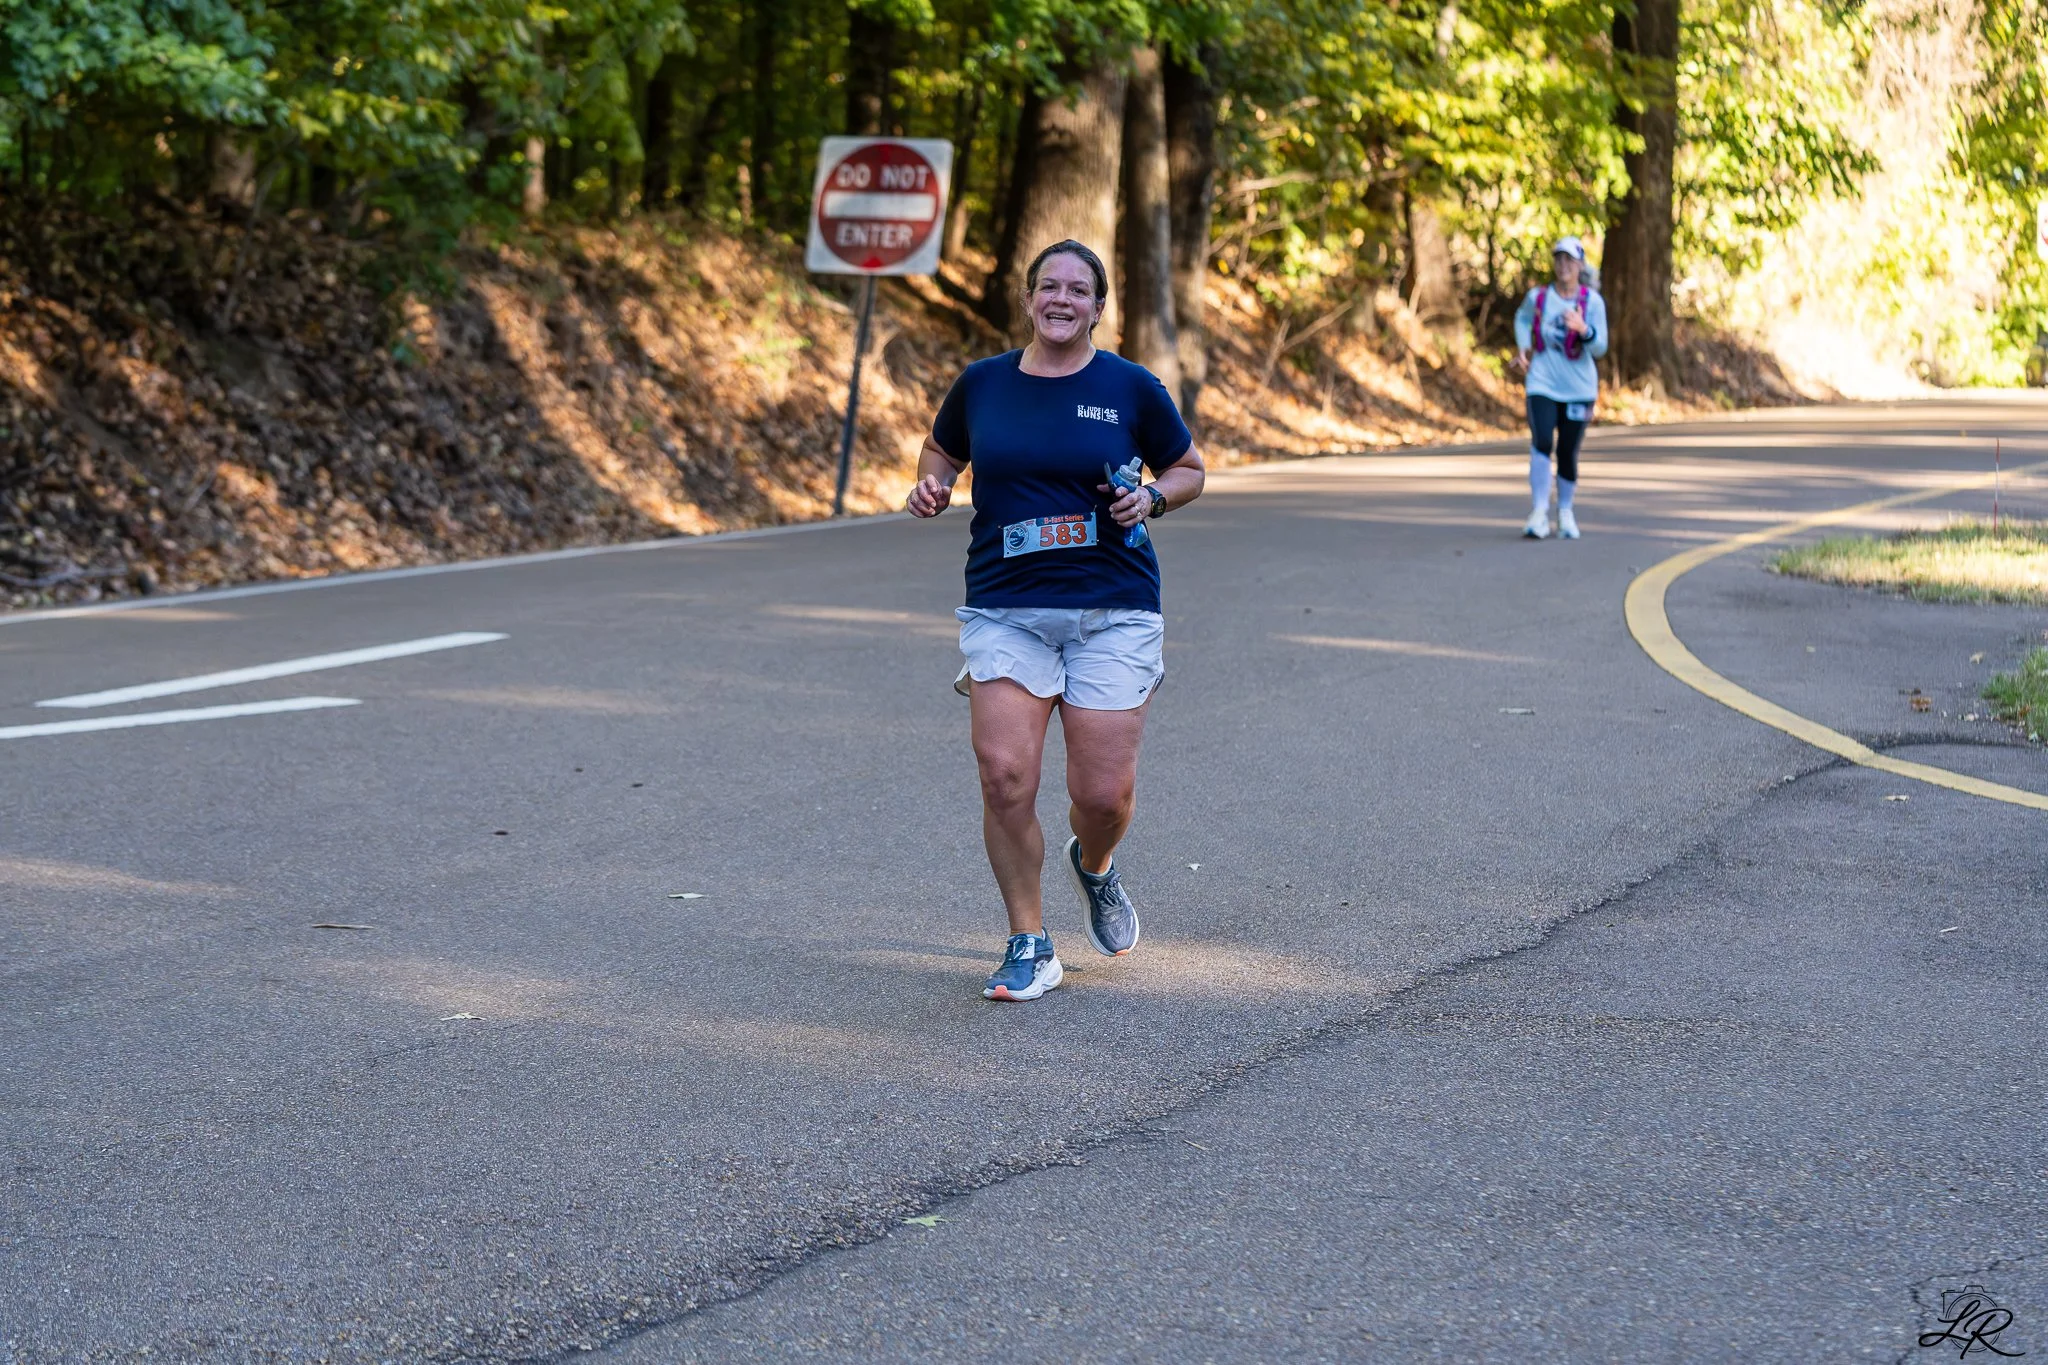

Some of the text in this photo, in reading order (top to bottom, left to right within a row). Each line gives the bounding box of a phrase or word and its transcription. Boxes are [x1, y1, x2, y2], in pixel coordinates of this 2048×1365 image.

[836, 163, 929, 189] DO NOT
[836, 222, 913, 248] ENTER
[1064, 514, 1084, 522] Series
[1040, 522, 1087, 547] 583
